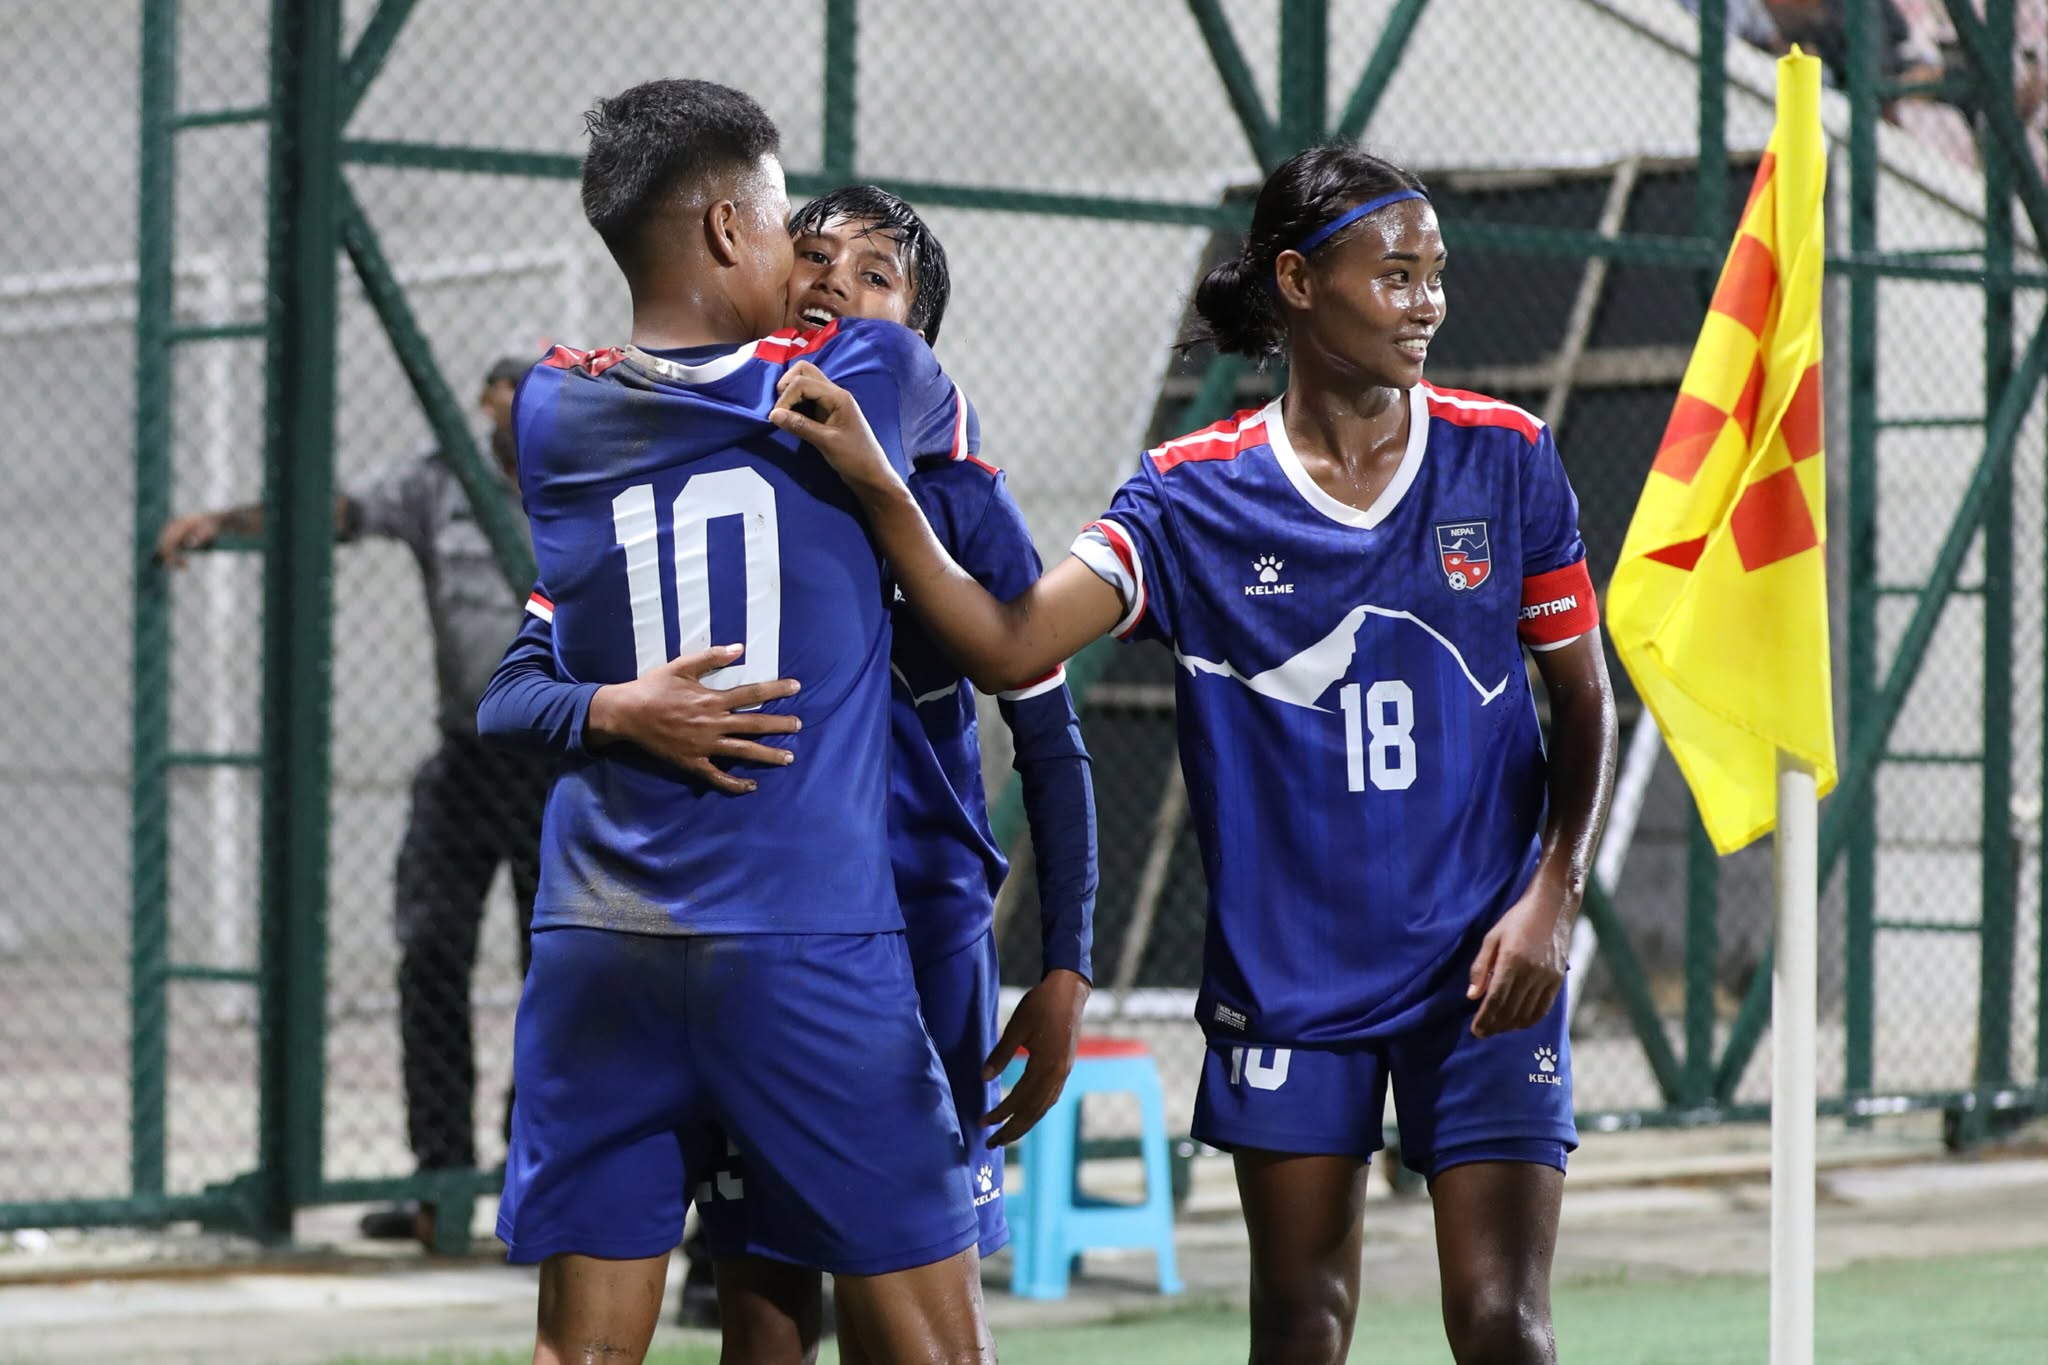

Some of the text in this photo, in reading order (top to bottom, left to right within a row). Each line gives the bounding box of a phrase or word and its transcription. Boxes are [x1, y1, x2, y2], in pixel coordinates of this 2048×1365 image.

[1450, 527, 1475, 537] NEPAL
[612, 466, 780, 711] 10
[1245, 584, 1295, 596] KELME
[1340, 680, 1417, 793] 18
